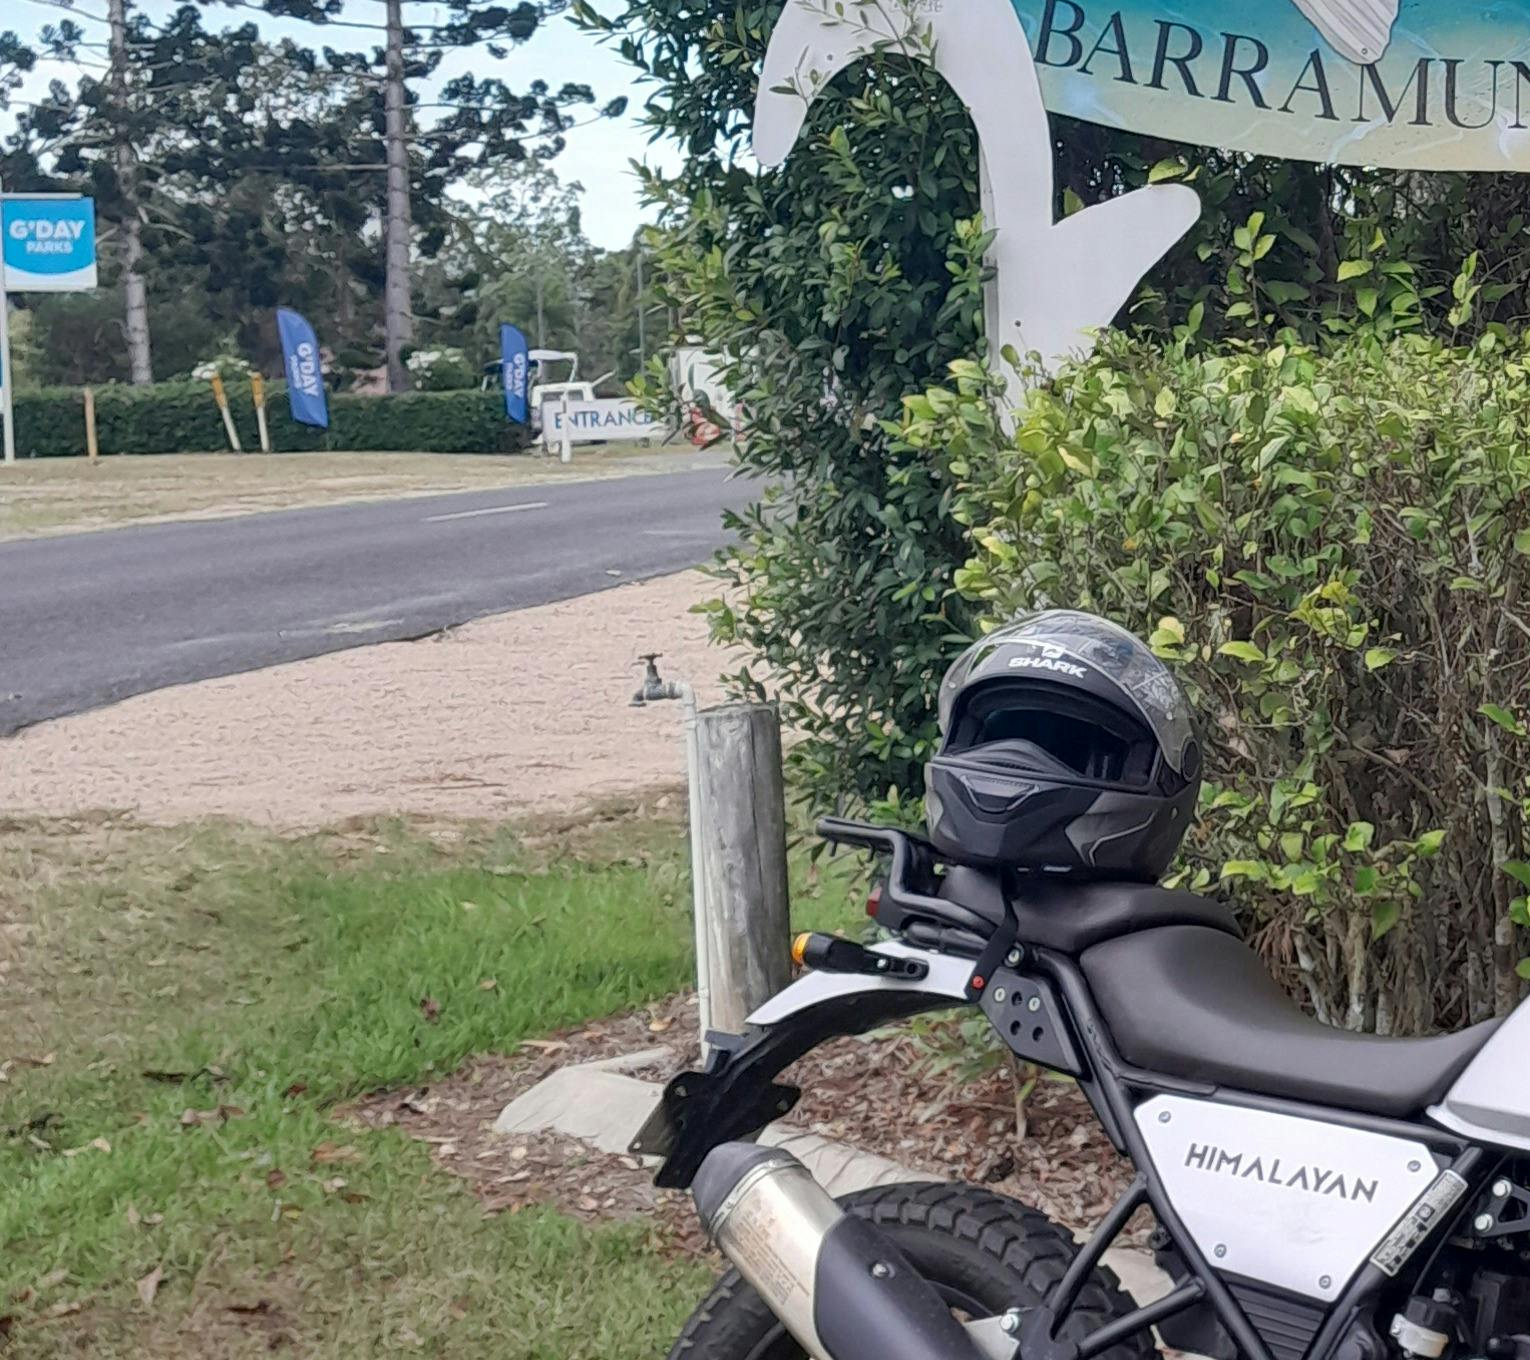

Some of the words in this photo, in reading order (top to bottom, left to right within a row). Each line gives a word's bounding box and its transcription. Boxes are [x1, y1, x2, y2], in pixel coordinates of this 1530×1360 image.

[9, 219, 86, 240] G'DAY
[1008, 657, 1087, 678] SHARK
[1184, 1142, 1379, 1204] HIMALAYAN
